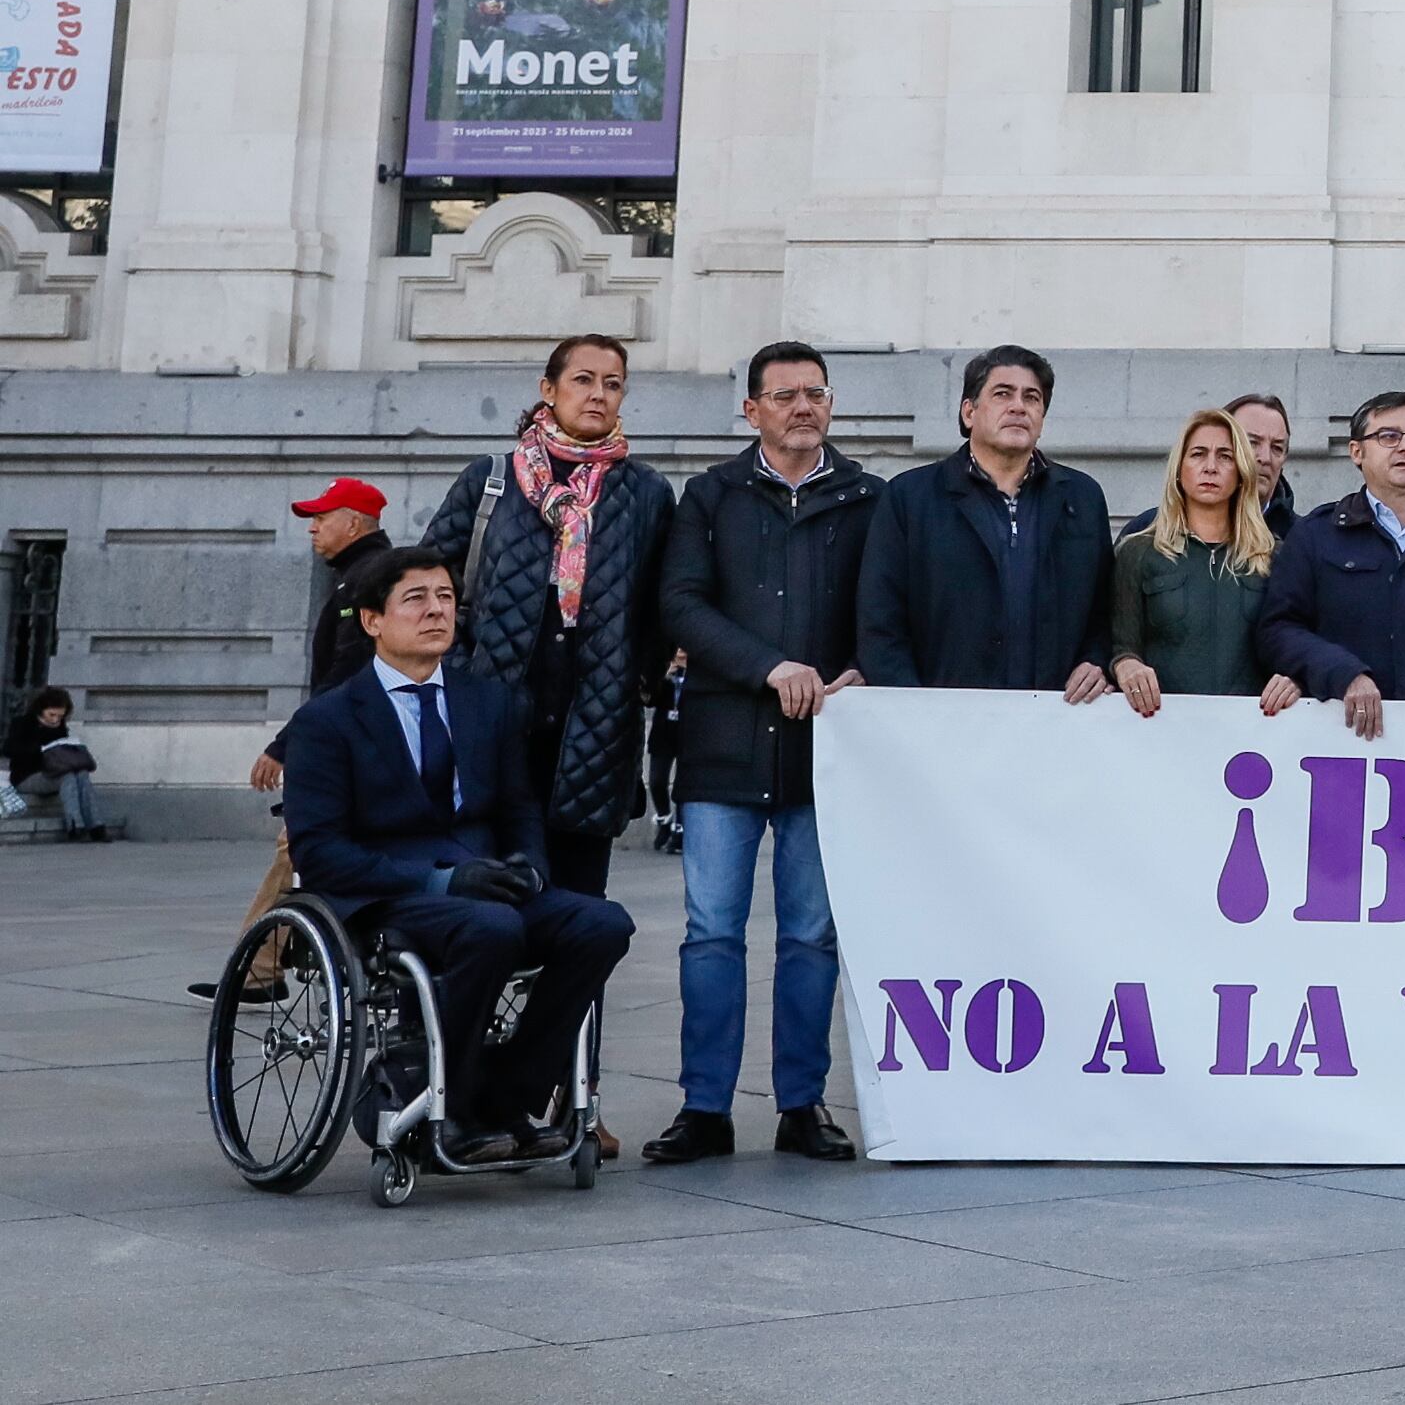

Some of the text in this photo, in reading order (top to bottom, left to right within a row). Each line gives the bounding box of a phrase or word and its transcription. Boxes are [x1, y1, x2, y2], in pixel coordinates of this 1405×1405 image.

[7, 66, 77, 91] ESTO
[455, 39, 639, 85] Monet
[452, 127, 464, 136] 21
[465, 127, 520, 137] septiembre
[522, 127, 547, 136] 2023
[556, 127, 568, 136] 25
[569, 127, 606, 136] febrero
[607, 127, 633, 136] 2024
[877, 979, 1045, 1074] NO
[1082, 982, 1166, 1075] A
[1209, 984, 1358, 1077] LA
